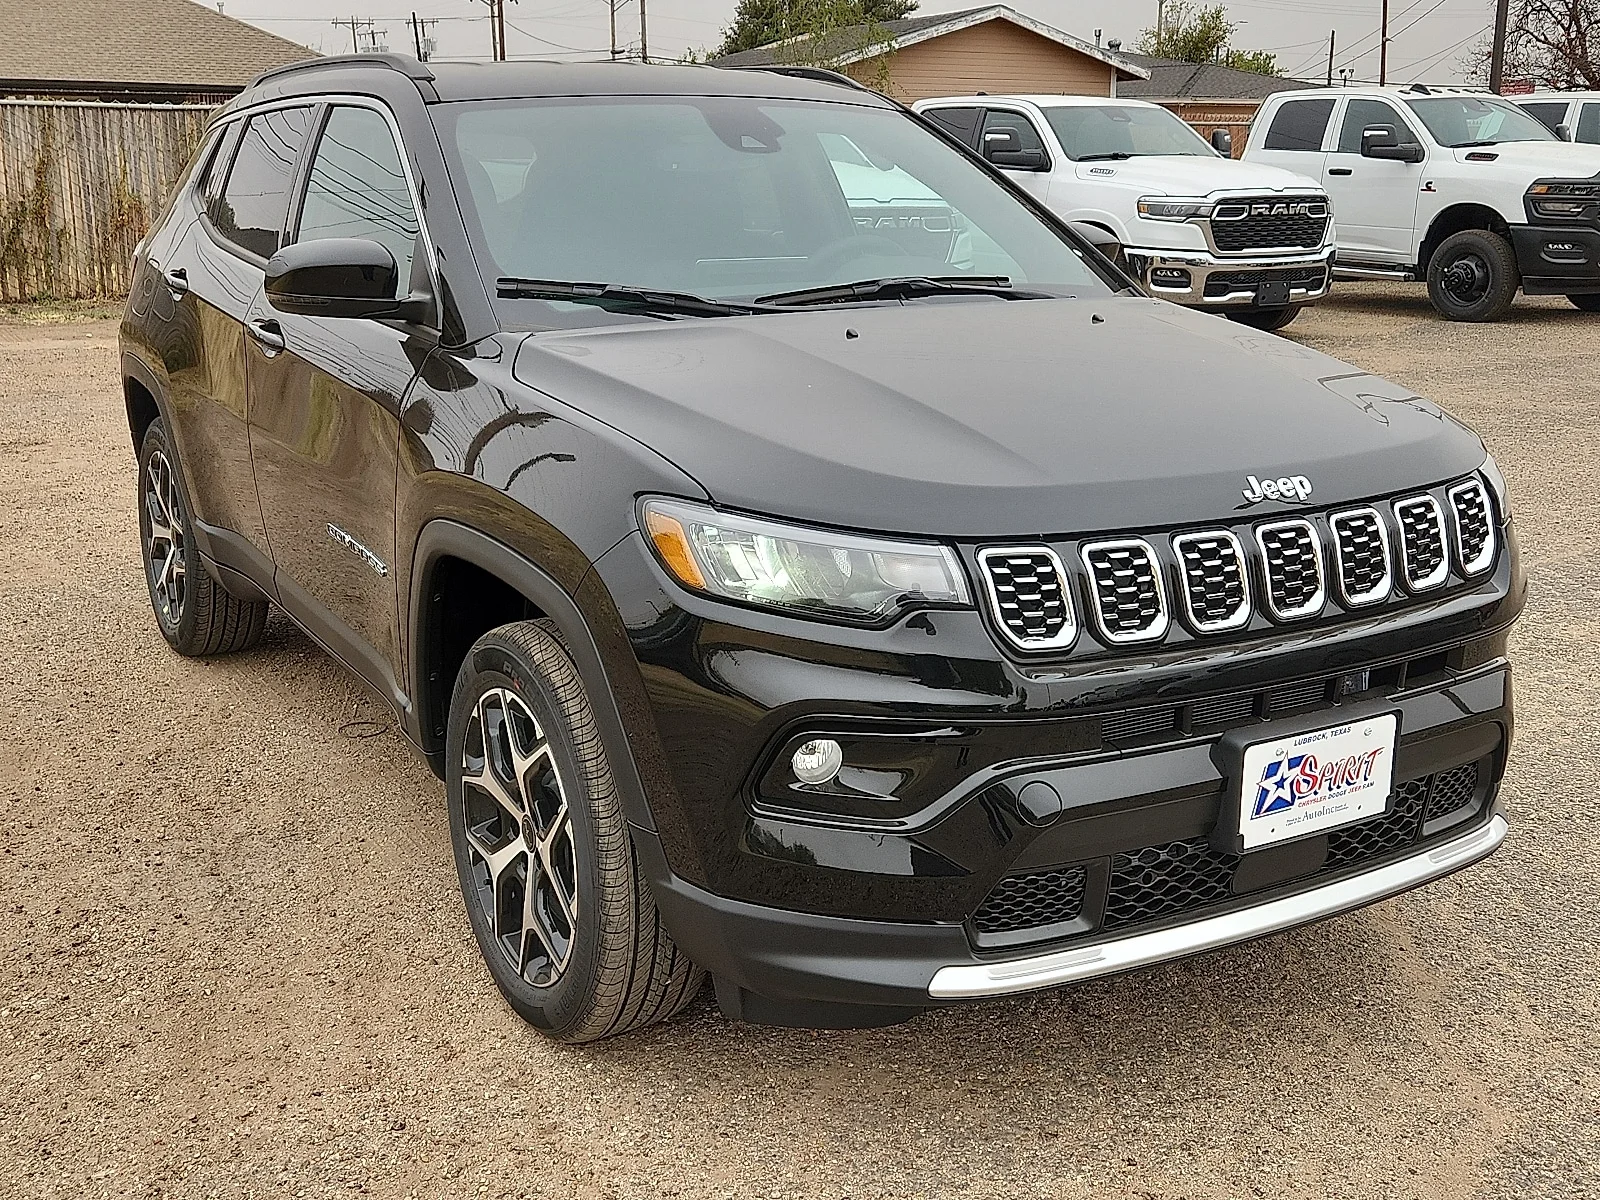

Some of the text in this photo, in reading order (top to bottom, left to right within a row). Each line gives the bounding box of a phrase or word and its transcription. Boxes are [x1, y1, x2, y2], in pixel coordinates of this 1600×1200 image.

[1251, 203, 1308, 216] RAM
[1242, 474, 1313, 503] Jeep
[1330, 726, 1352, 738] TEXAS
[1297, 795, 1327, 808] CHRYSLER
